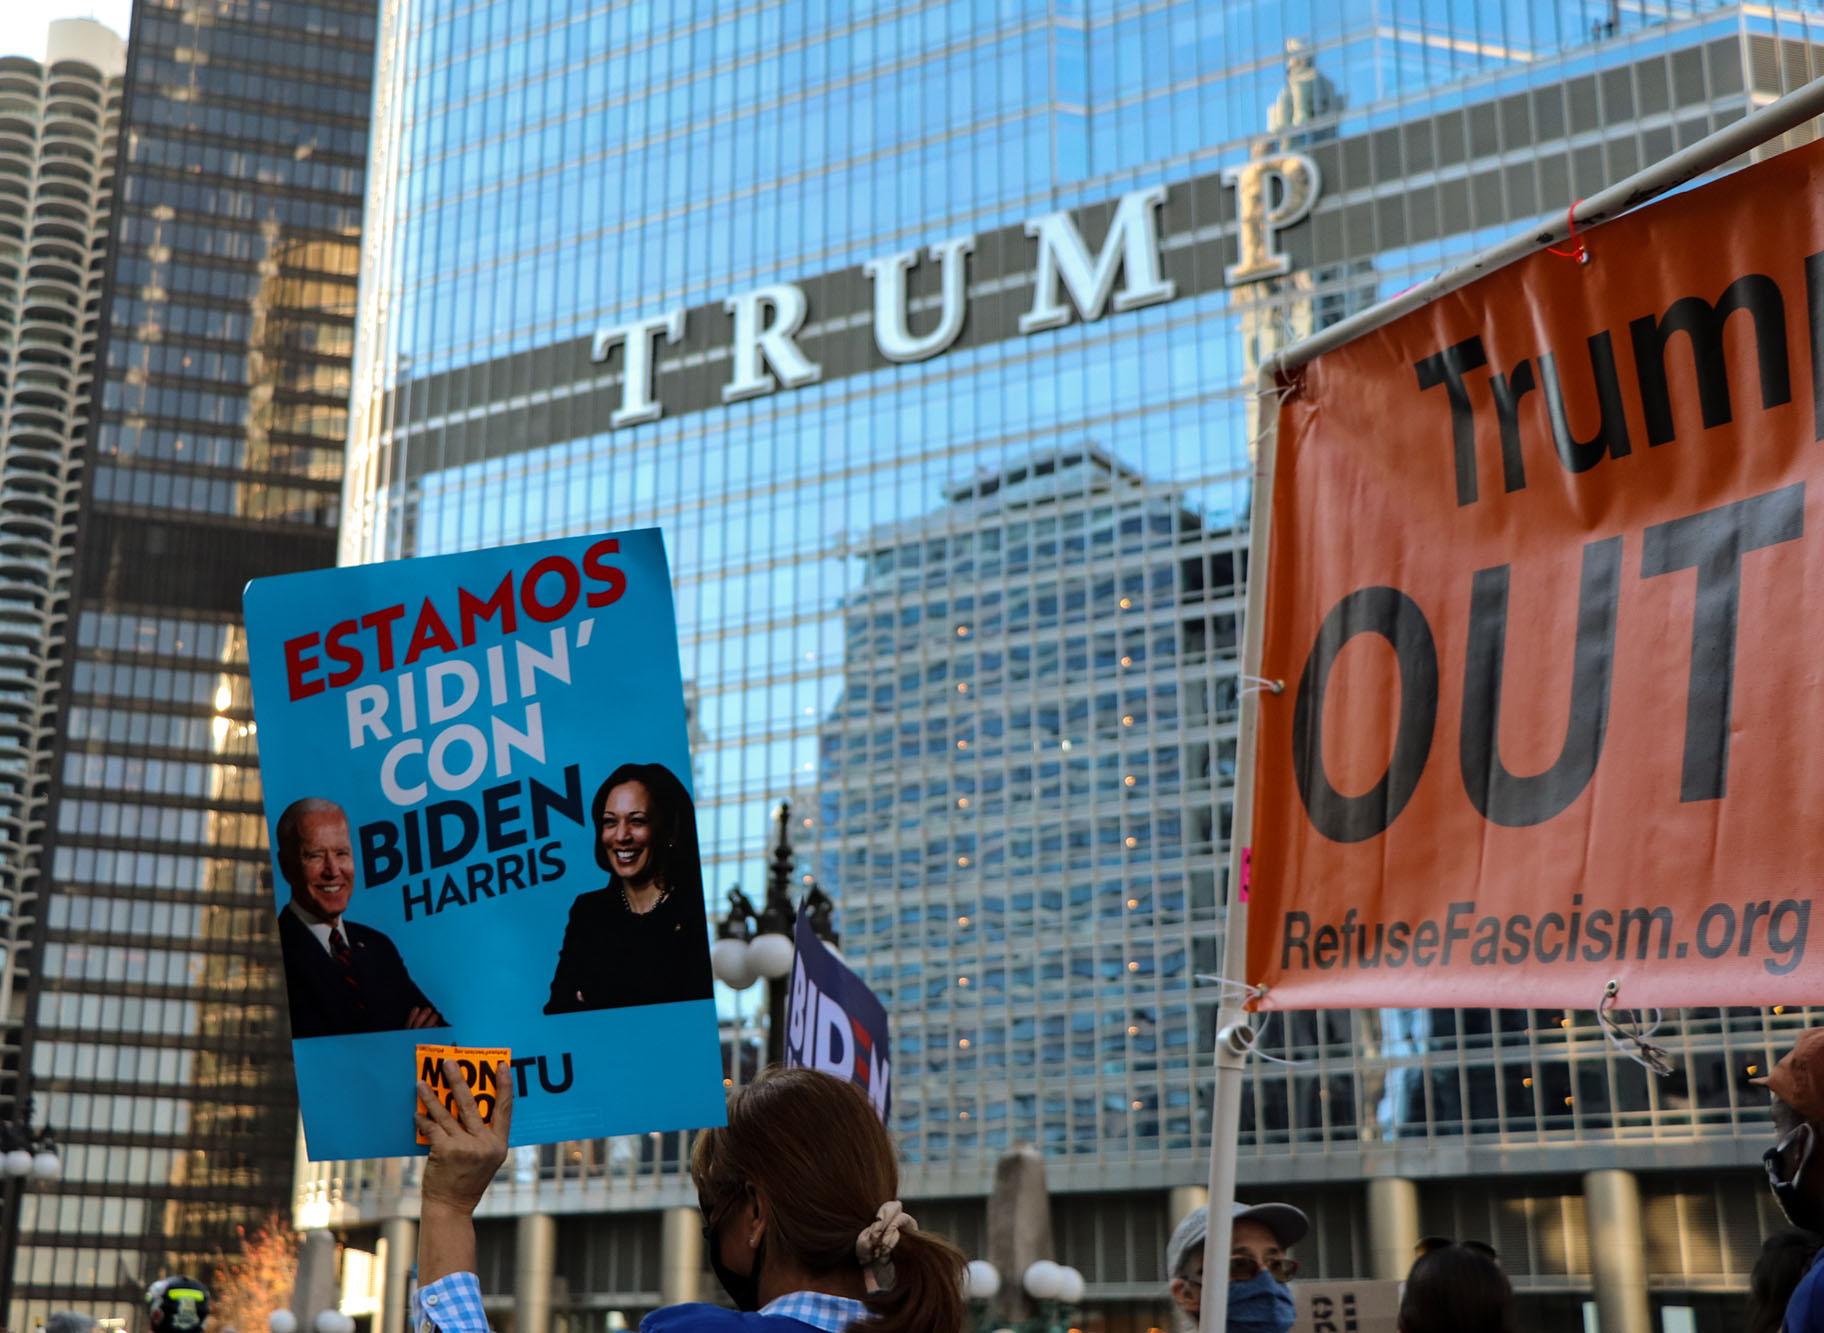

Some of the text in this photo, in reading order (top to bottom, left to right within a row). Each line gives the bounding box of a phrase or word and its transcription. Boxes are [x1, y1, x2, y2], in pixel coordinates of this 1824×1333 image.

[593, 155, 1321, 428] TRUMP
[284, 538, 627, 702] ESTAMOS
[1292, 482, 1806, 843] OUT
[380, 702, 546, 806] CON
[359, 764, 585, 889] BIDEN
[403, 841, 566, 922] HARRIS
[1280, 894, 1812, 976] RefuseFascism.org
